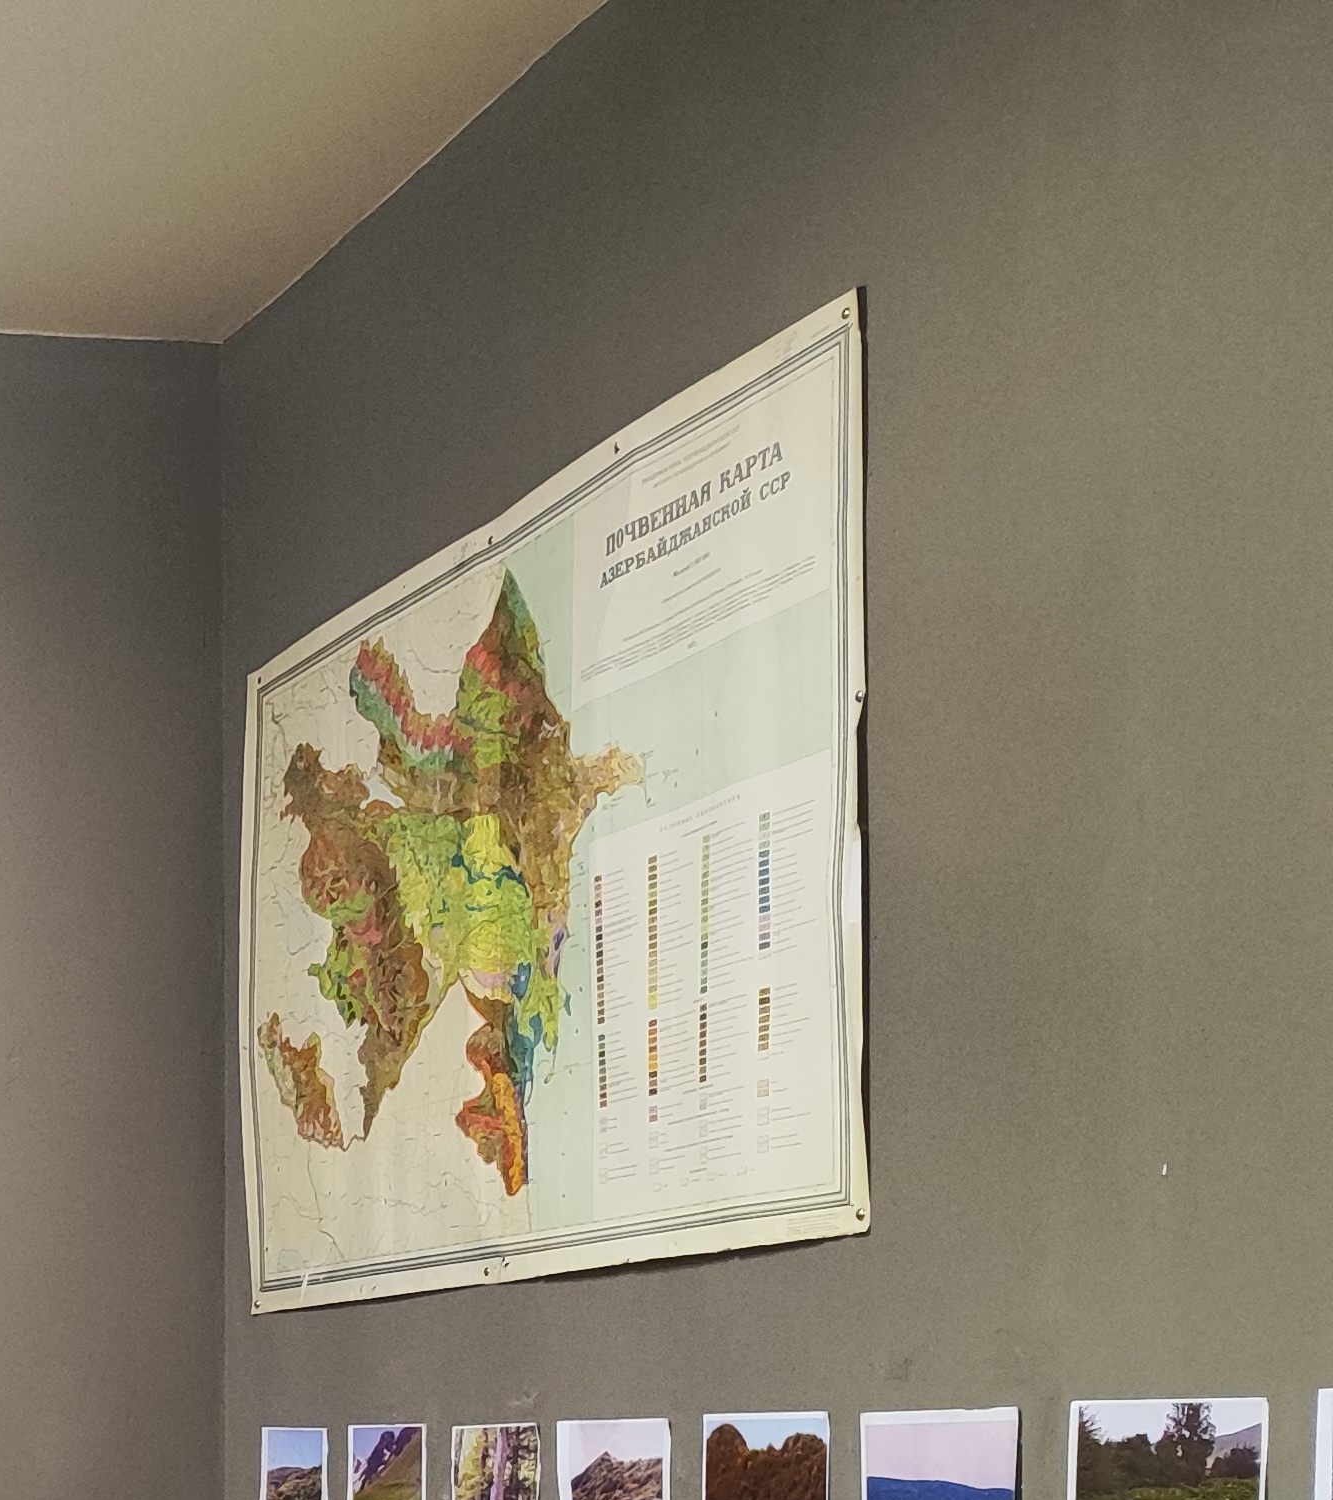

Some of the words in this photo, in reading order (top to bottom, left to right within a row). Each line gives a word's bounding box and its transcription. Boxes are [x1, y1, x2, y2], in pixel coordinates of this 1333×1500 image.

[599, 487, 753, 589] АЗЕРБАЙДЖАНСКОЙ
[759, 471, 792, 502] ССР
[605, 481, 712, 557] ПОЧВЕННАЯ
[719, 441, 784, 494] КАРТА
